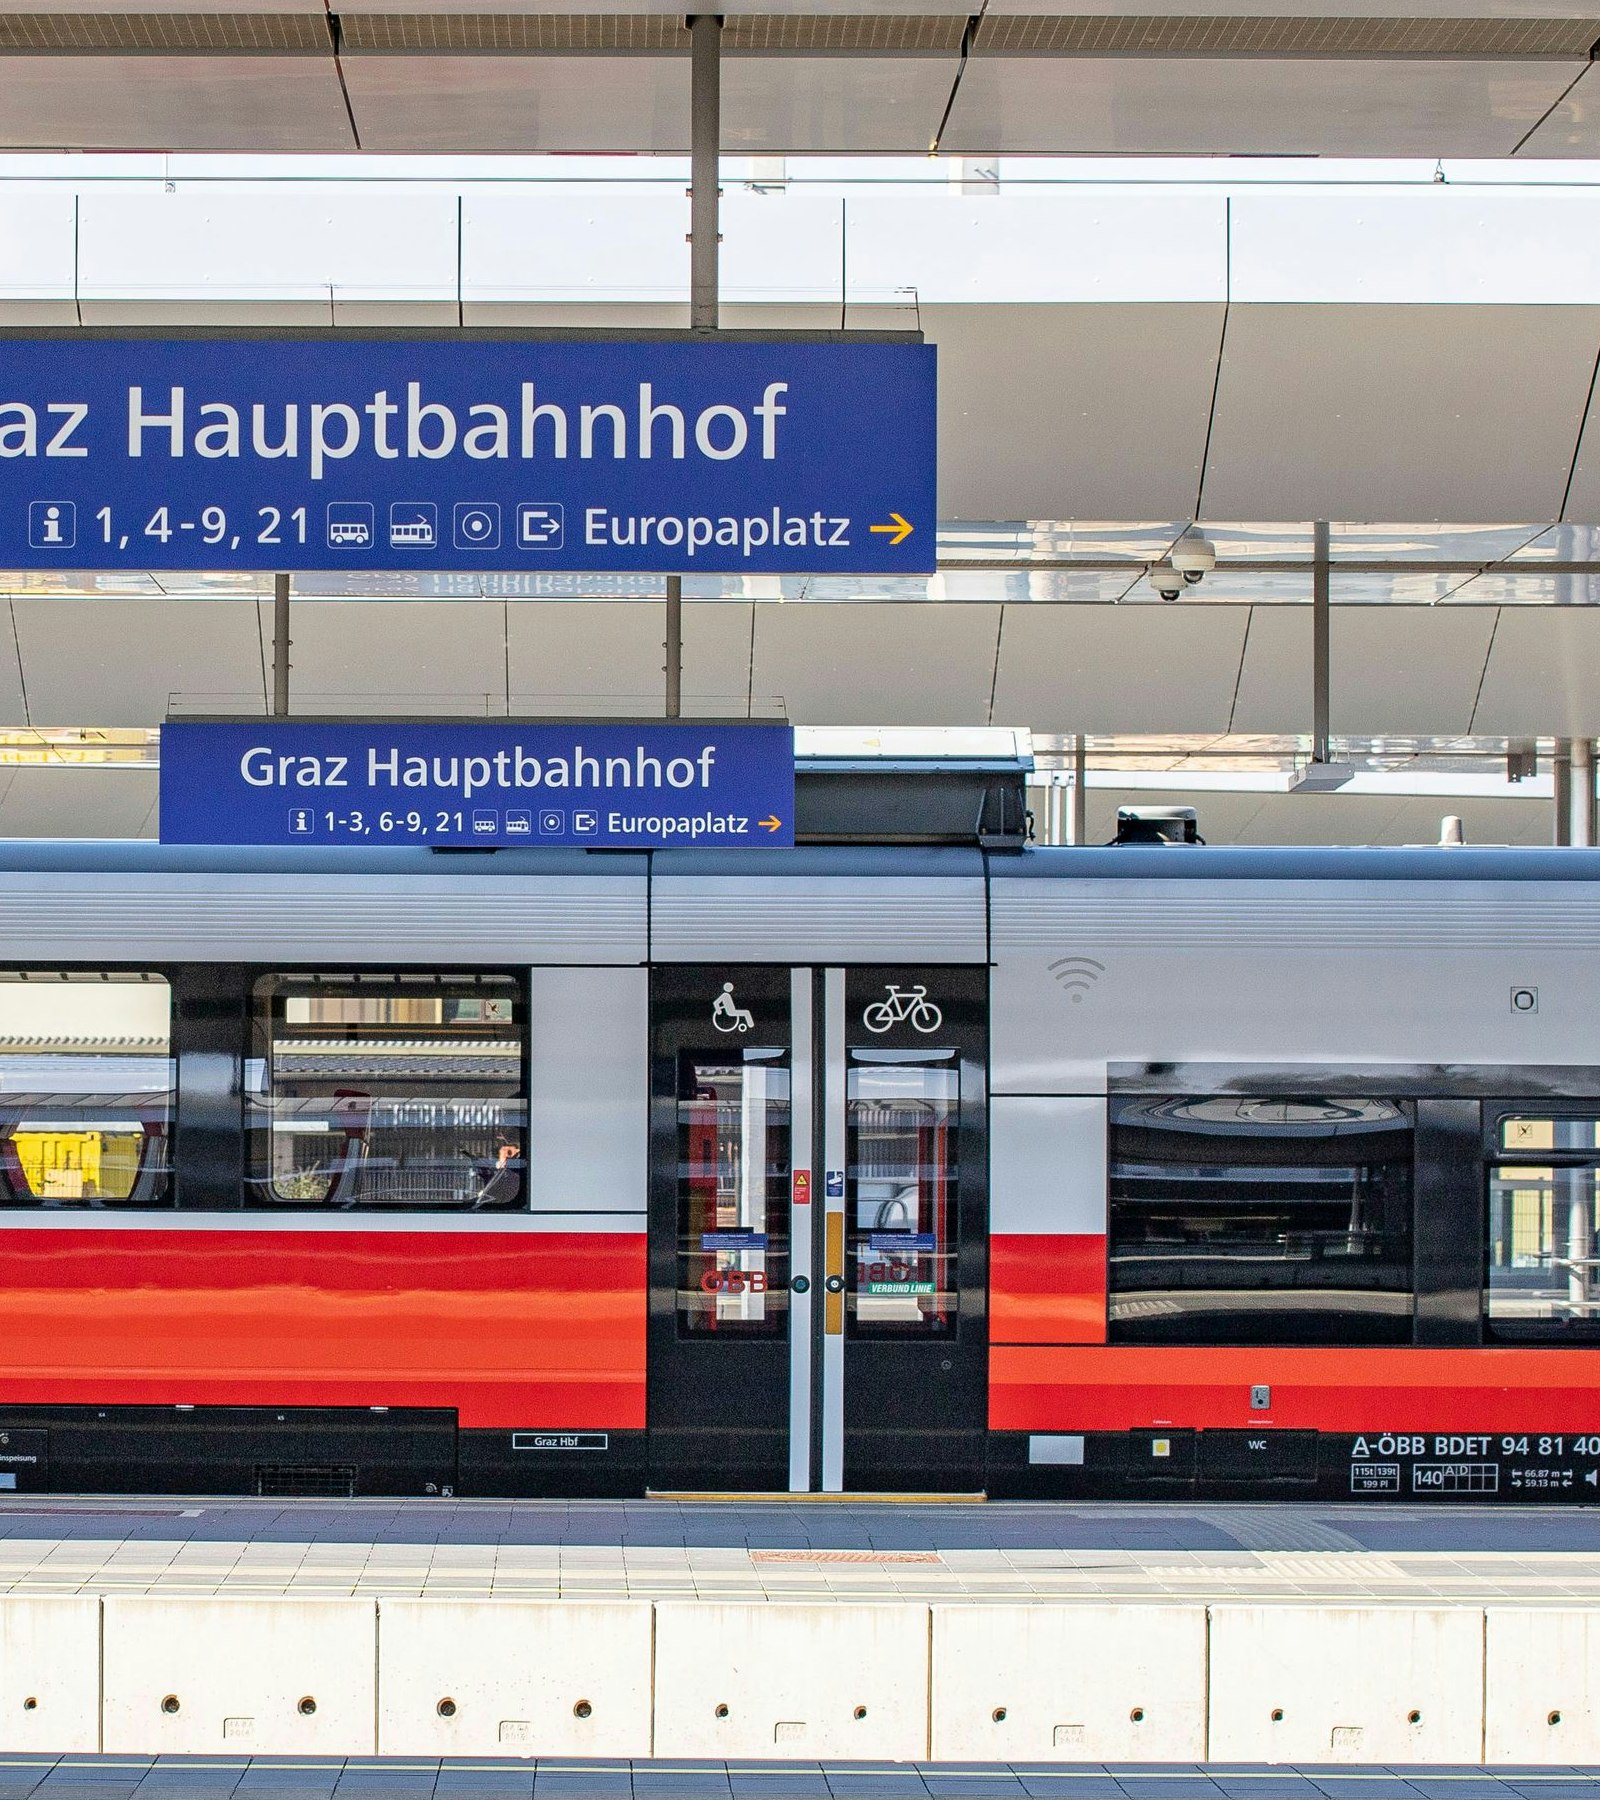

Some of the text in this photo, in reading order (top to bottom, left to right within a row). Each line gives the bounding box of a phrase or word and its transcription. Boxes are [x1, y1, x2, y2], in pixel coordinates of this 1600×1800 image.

[128, 381, 789, 480] Hauptbahnhof
[96, 506, 129, 550] 1,
[257, 506, 306, 544] 21
[585, 506, 850, 556] Europaplatz
[240, 745, 716, 798] Graz Hauptbahnhof
[325, 811, 749, 839] 1-3, 6-9, 21 Europaplatz
[872, 1284, 932, 1293] VERBUND LINIE
[534, 1436, 579, 1446] Graz Hbf
[1248, 1440, 1267, 1450] WC
[1351, 1432, 1600, 1457] A-ÖBB BDET 94 81 40
[1354, 1467, 1396, 1476] 115t 139t
[1445, 1466, 1469, 1475] A D
[1524, 1469, 1560, 1478] 66.87 m
[1415, 1470, 1442, 1485] 140
[1363, 1480, 1378, 1488] 199
[1524, 1479, 1549, 1487] 59.13
